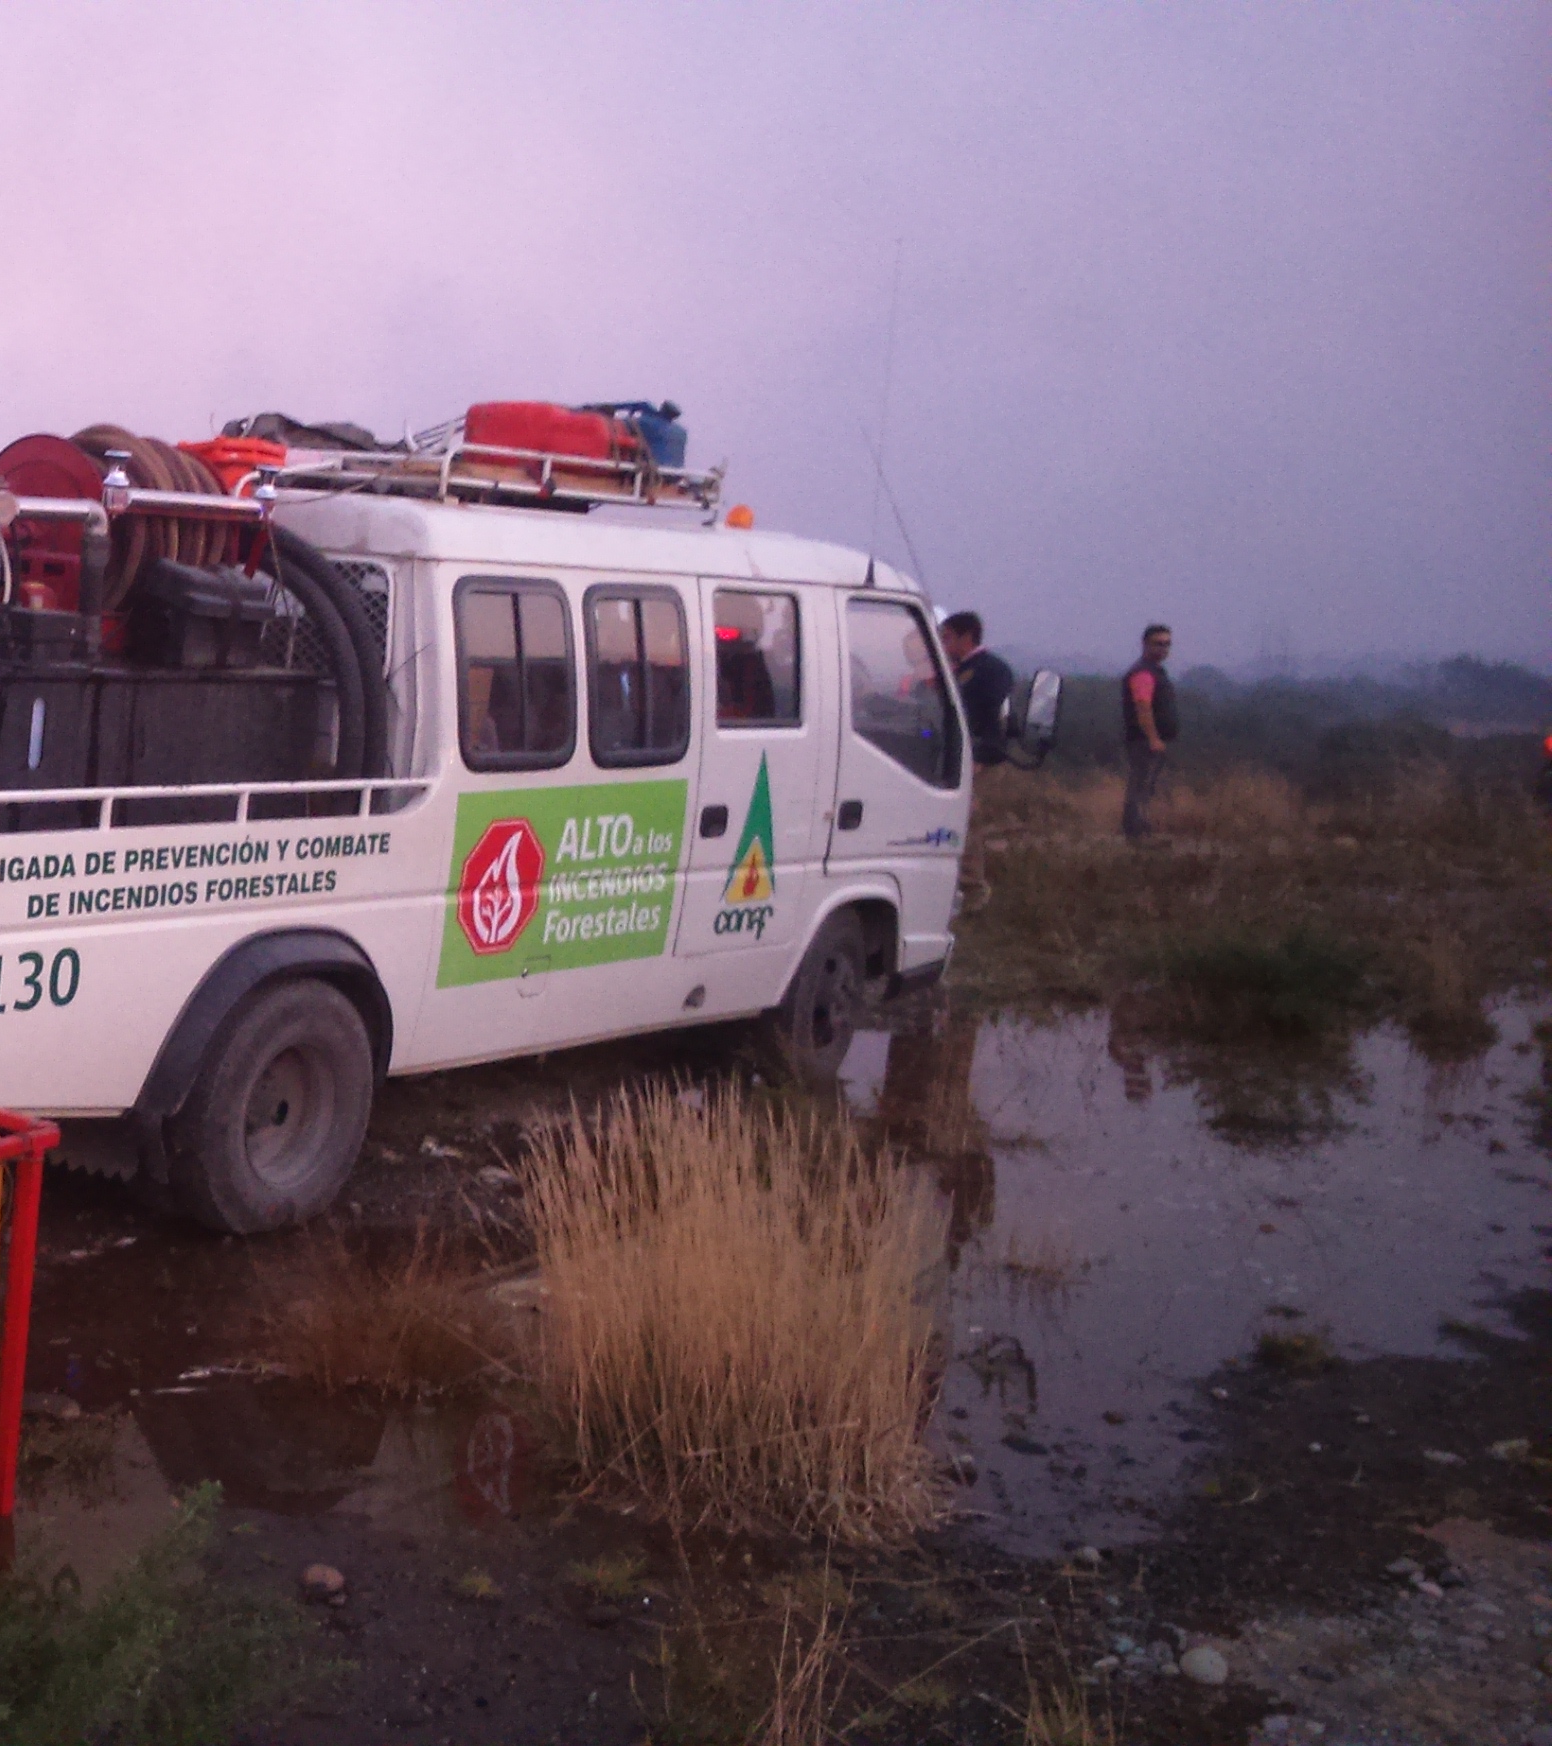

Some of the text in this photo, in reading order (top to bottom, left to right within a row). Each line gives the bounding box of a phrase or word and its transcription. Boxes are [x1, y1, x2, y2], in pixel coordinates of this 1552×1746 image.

[84, 850, 117, 877] DE
[124, 835, 269, 873] PREVENCIÓN
[277, 839, 290, 861] Y
[296, 832, 391, 860] COMBATE
[555, 813, 672, 863] ALTO a los
[27, 870, 337, 918] DE INCENDIOS FORESTALES
[549, 862, 668, 903] INCENDIOS
[543, 900, 661, 945] Forestales
